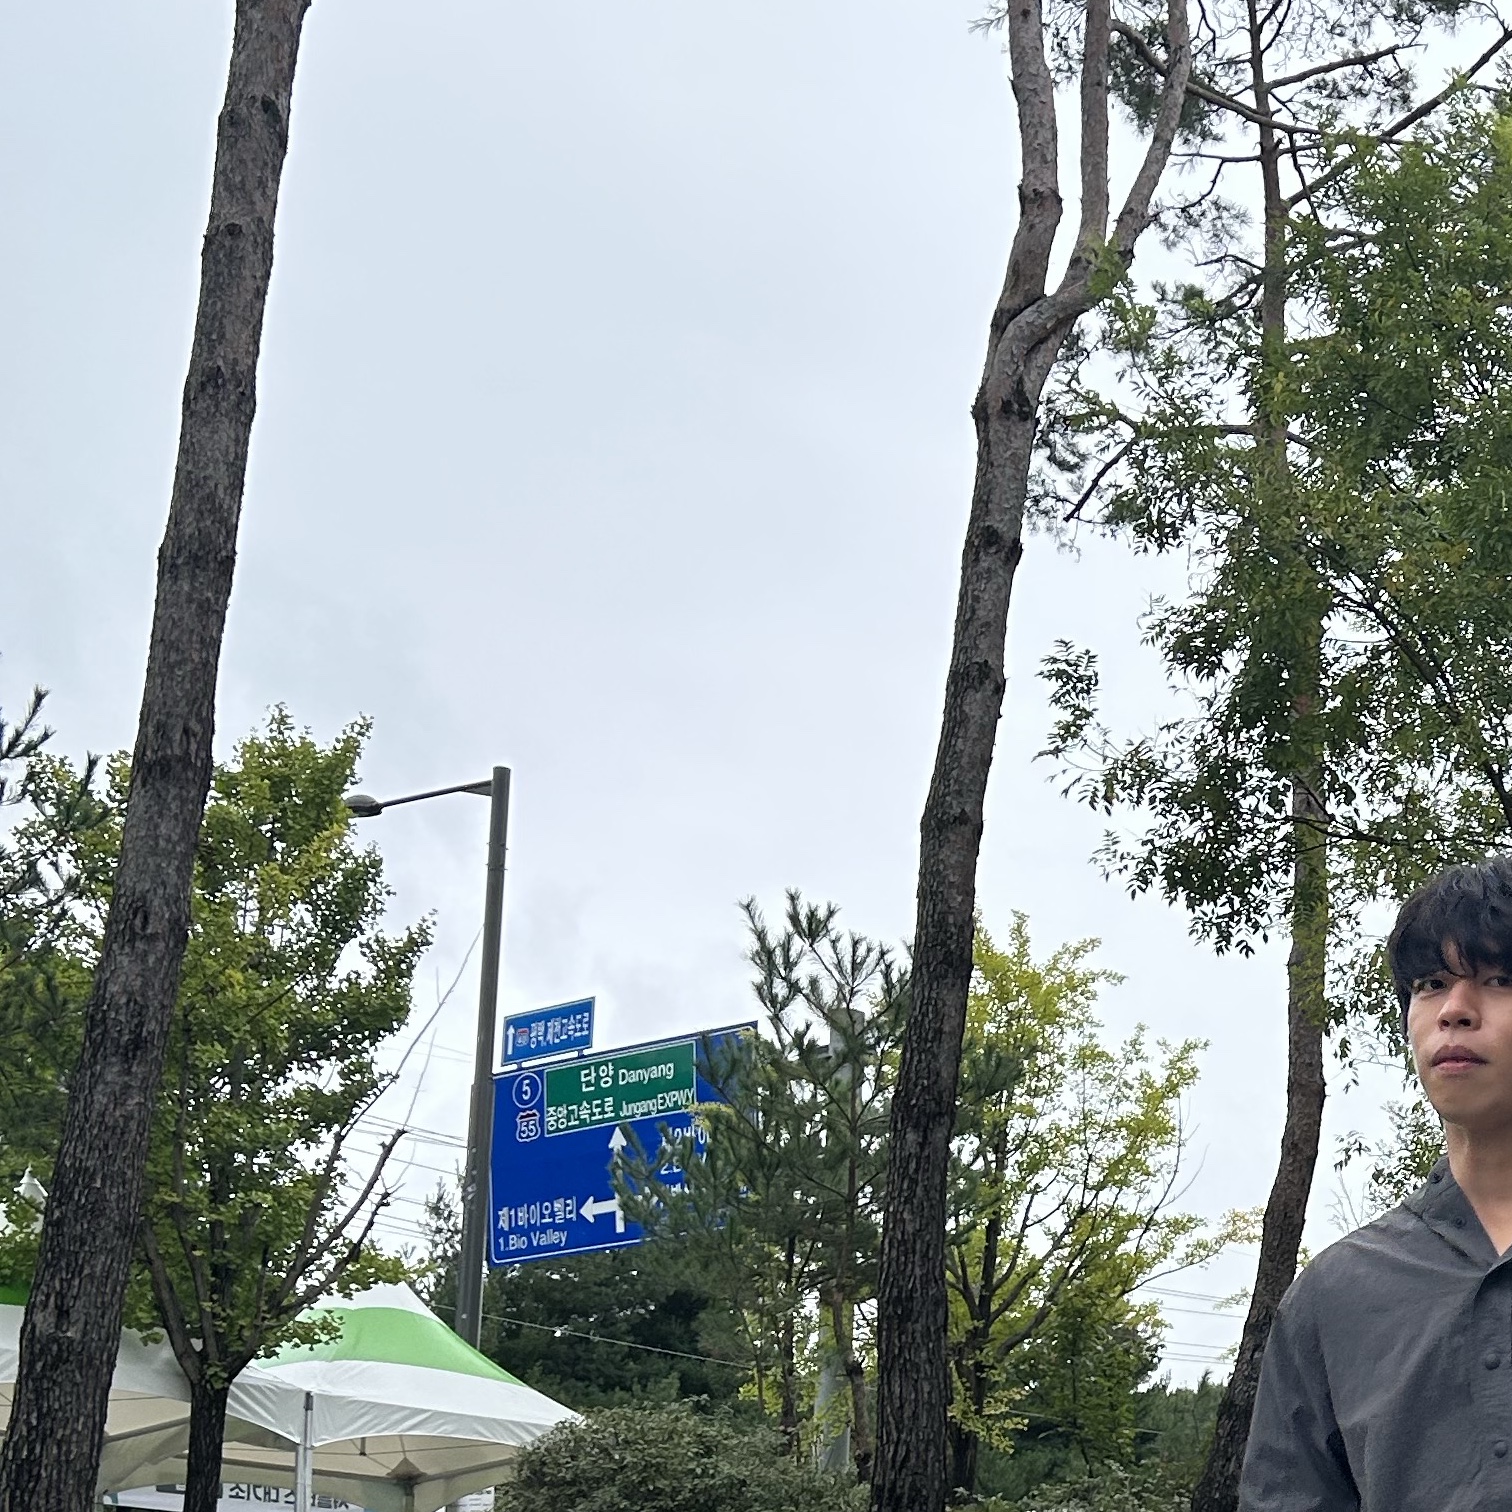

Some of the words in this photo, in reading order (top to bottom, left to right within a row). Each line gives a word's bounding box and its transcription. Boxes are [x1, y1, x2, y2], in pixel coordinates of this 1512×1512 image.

[580, 1062, 615, 1092] 단양
[618, 1062, 675, 1086] Danyang
[522, 1079, 531, 1101] 5
[546, 1096, 615, 1131] 중앙고속도로
[520, 1120, 536, 1138] 55
[498, 1233, 528, 1251] 1.Bio
[530, 1228, 568, 1247] Valley
